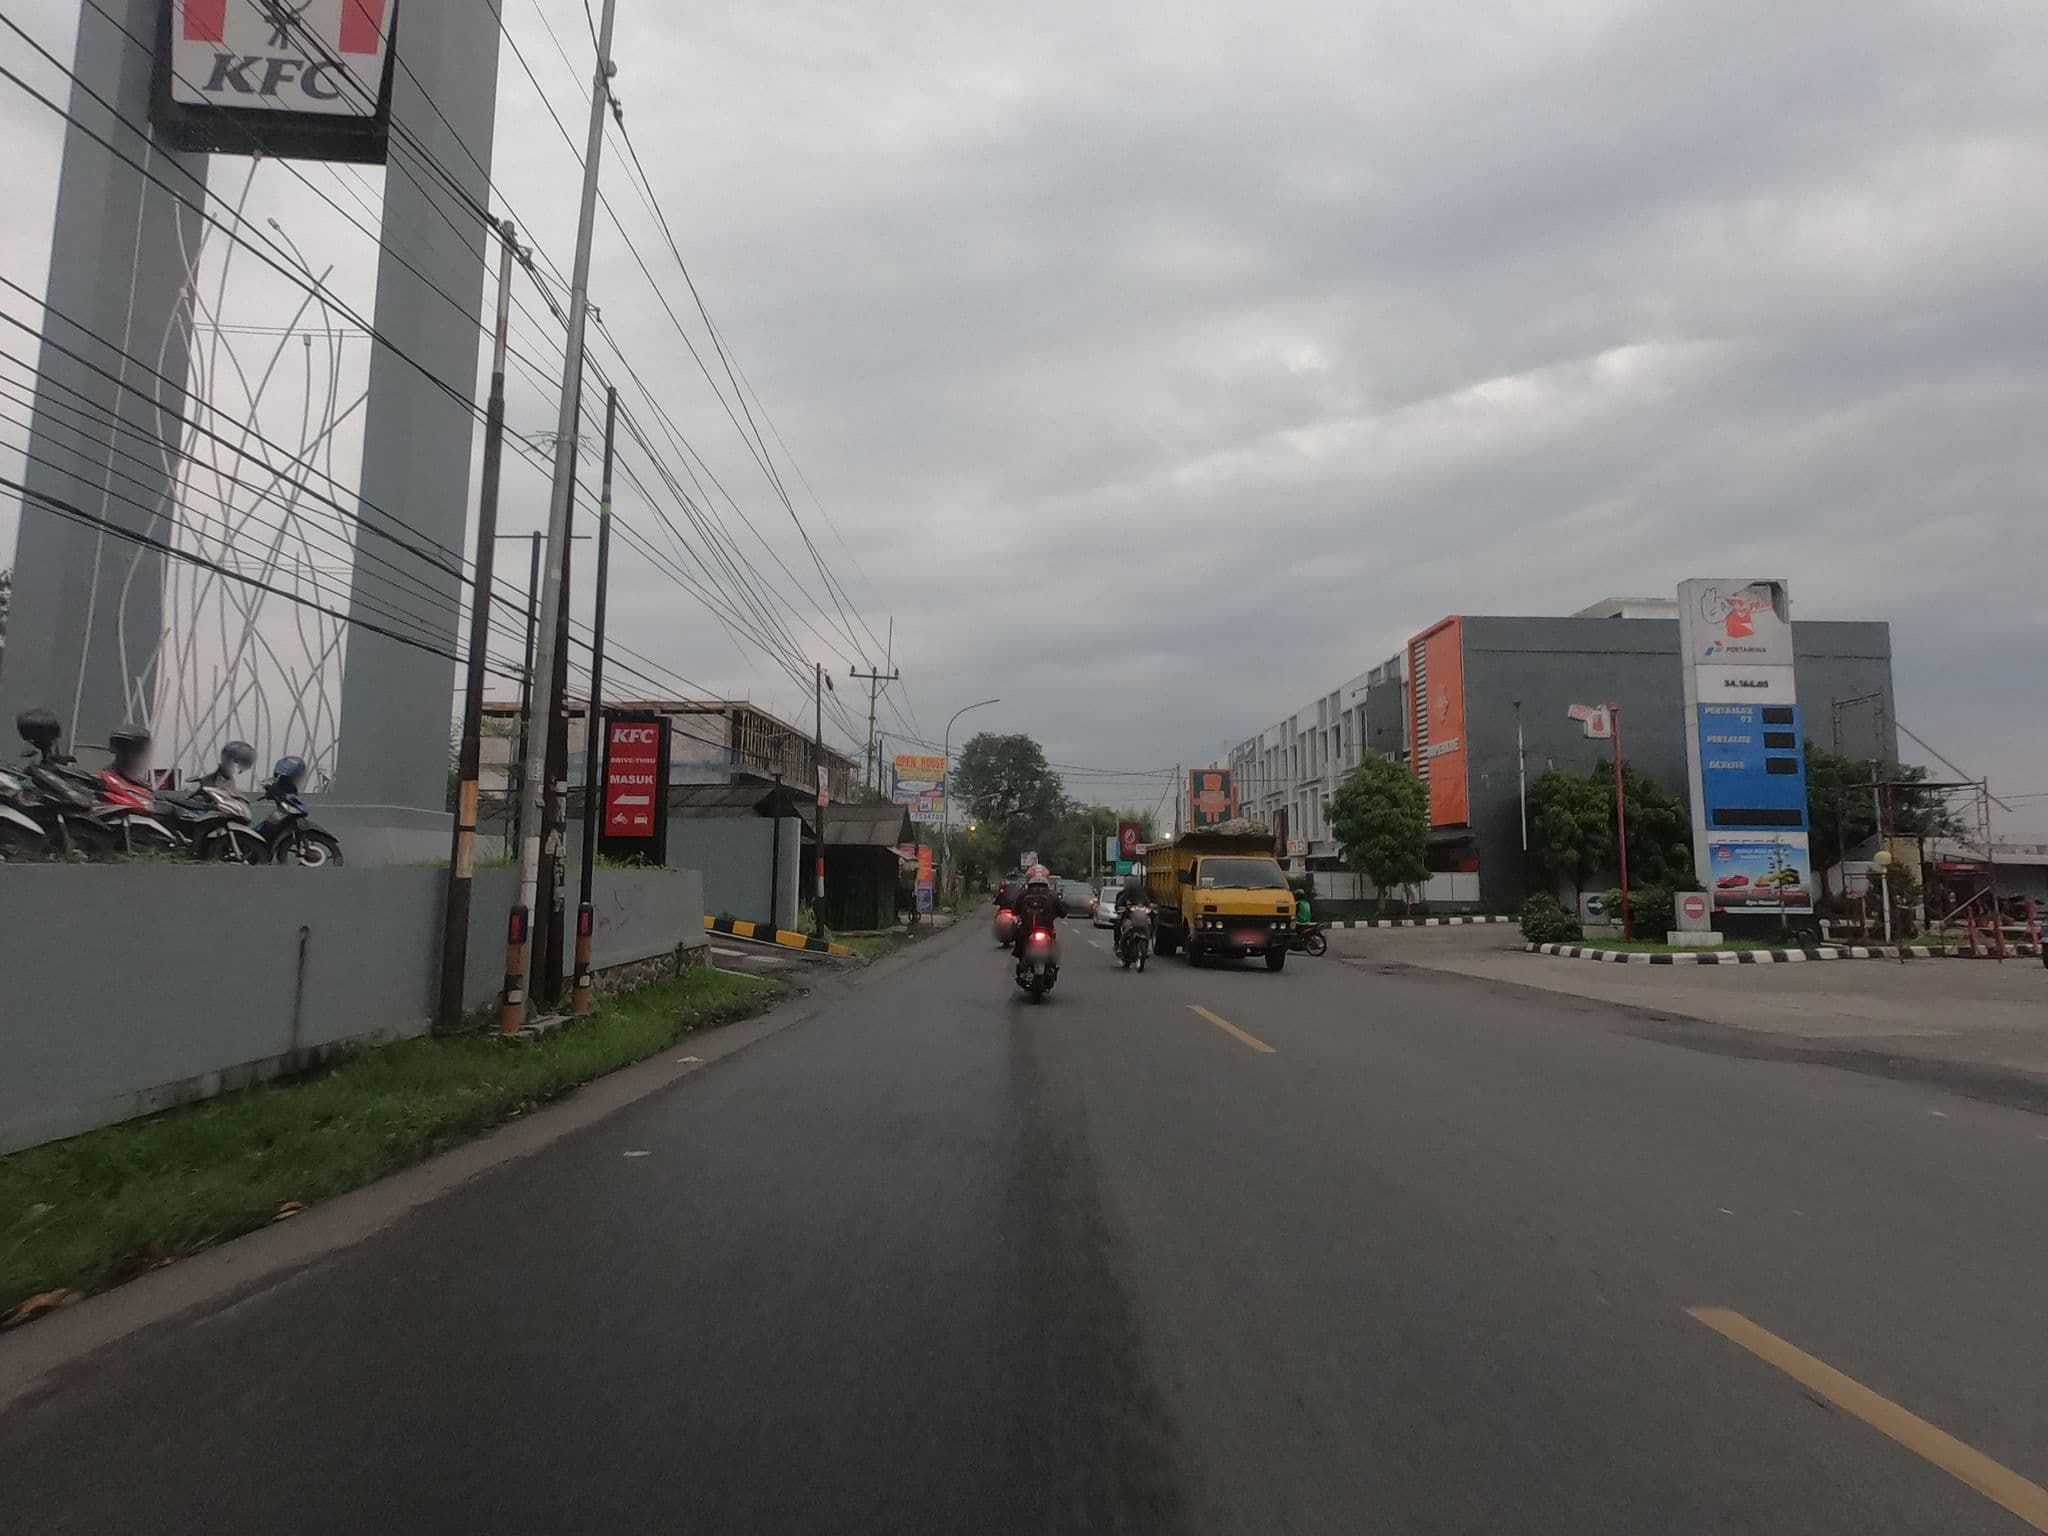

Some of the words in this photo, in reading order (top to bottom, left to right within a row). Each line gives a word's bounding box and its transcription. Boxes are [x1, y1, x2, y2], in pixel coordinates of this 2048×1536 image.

[203, 53, 344, 99] KFC
[612, 728, 653, 743] KFC
[609, 774, 653, 785] MASUK
